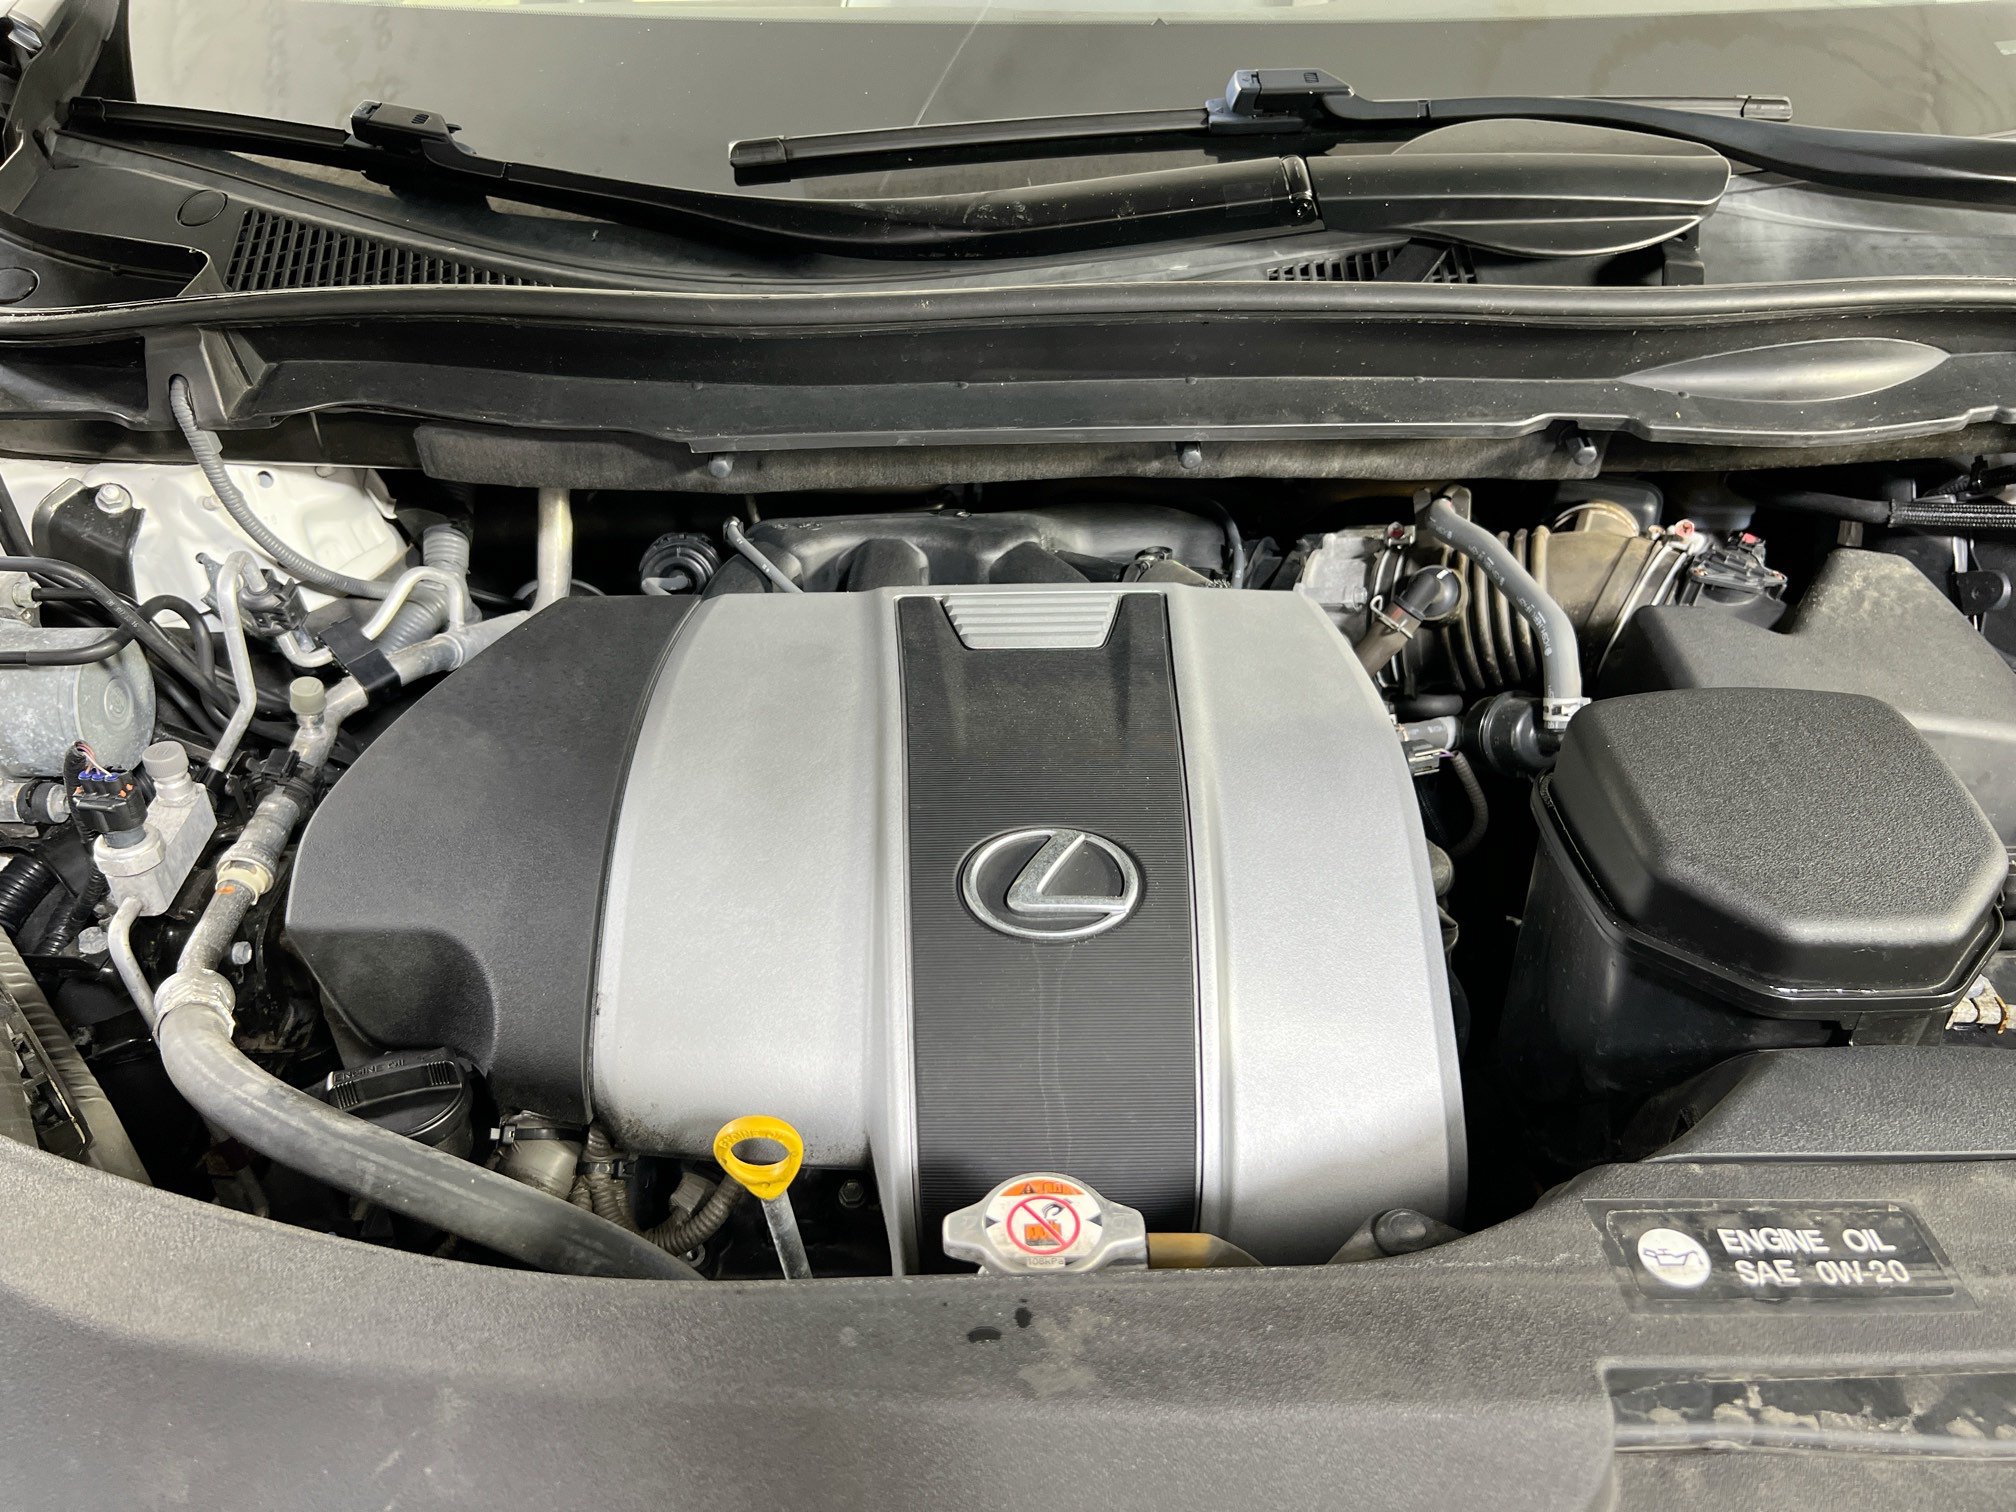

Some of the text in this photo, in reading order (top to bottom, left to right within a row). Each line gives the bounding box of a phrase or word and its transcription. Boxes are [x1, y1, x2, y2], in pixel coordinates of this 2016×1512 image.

[1716, 1227, 1897, 1254] ENGINE OIL
[1734, 1259, 1911, 1286] SAE 0W-20
